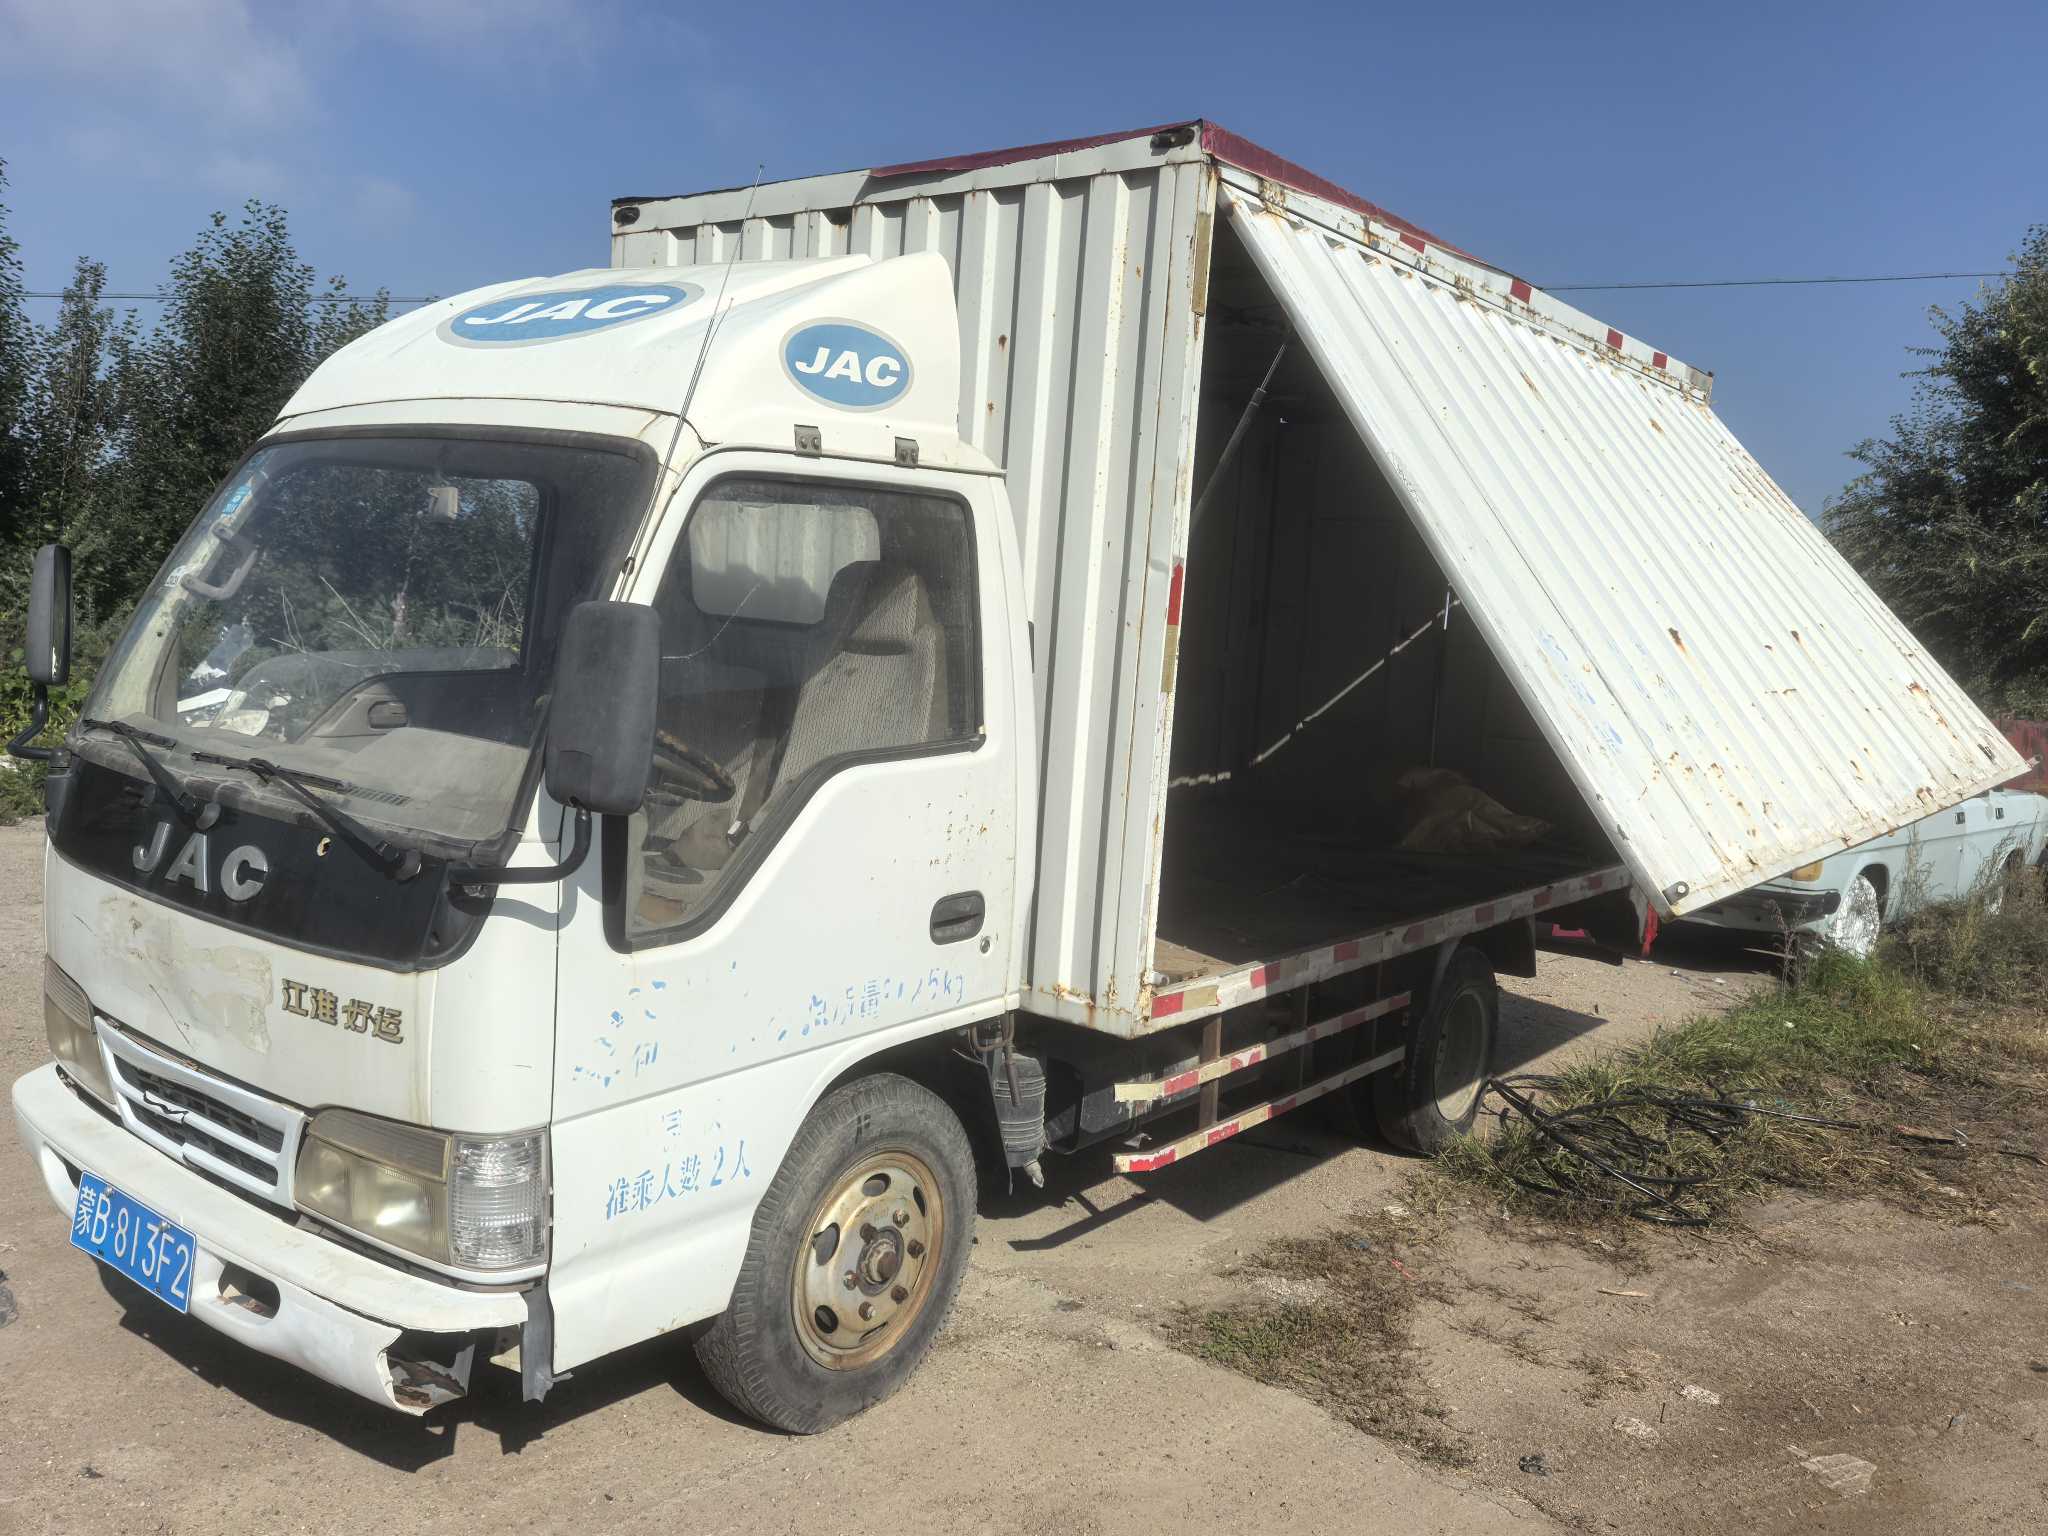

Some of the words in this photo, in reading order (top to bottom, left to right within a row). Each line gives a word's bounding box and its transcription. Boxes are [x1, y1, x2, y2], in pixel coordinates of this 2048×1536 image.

[464, 295, 672, 325] JAC
[795, 347, 901, 387] JAC
[132, 821, 269, 902] JAC
[281, 978, 404, 1044] 江淮好运
